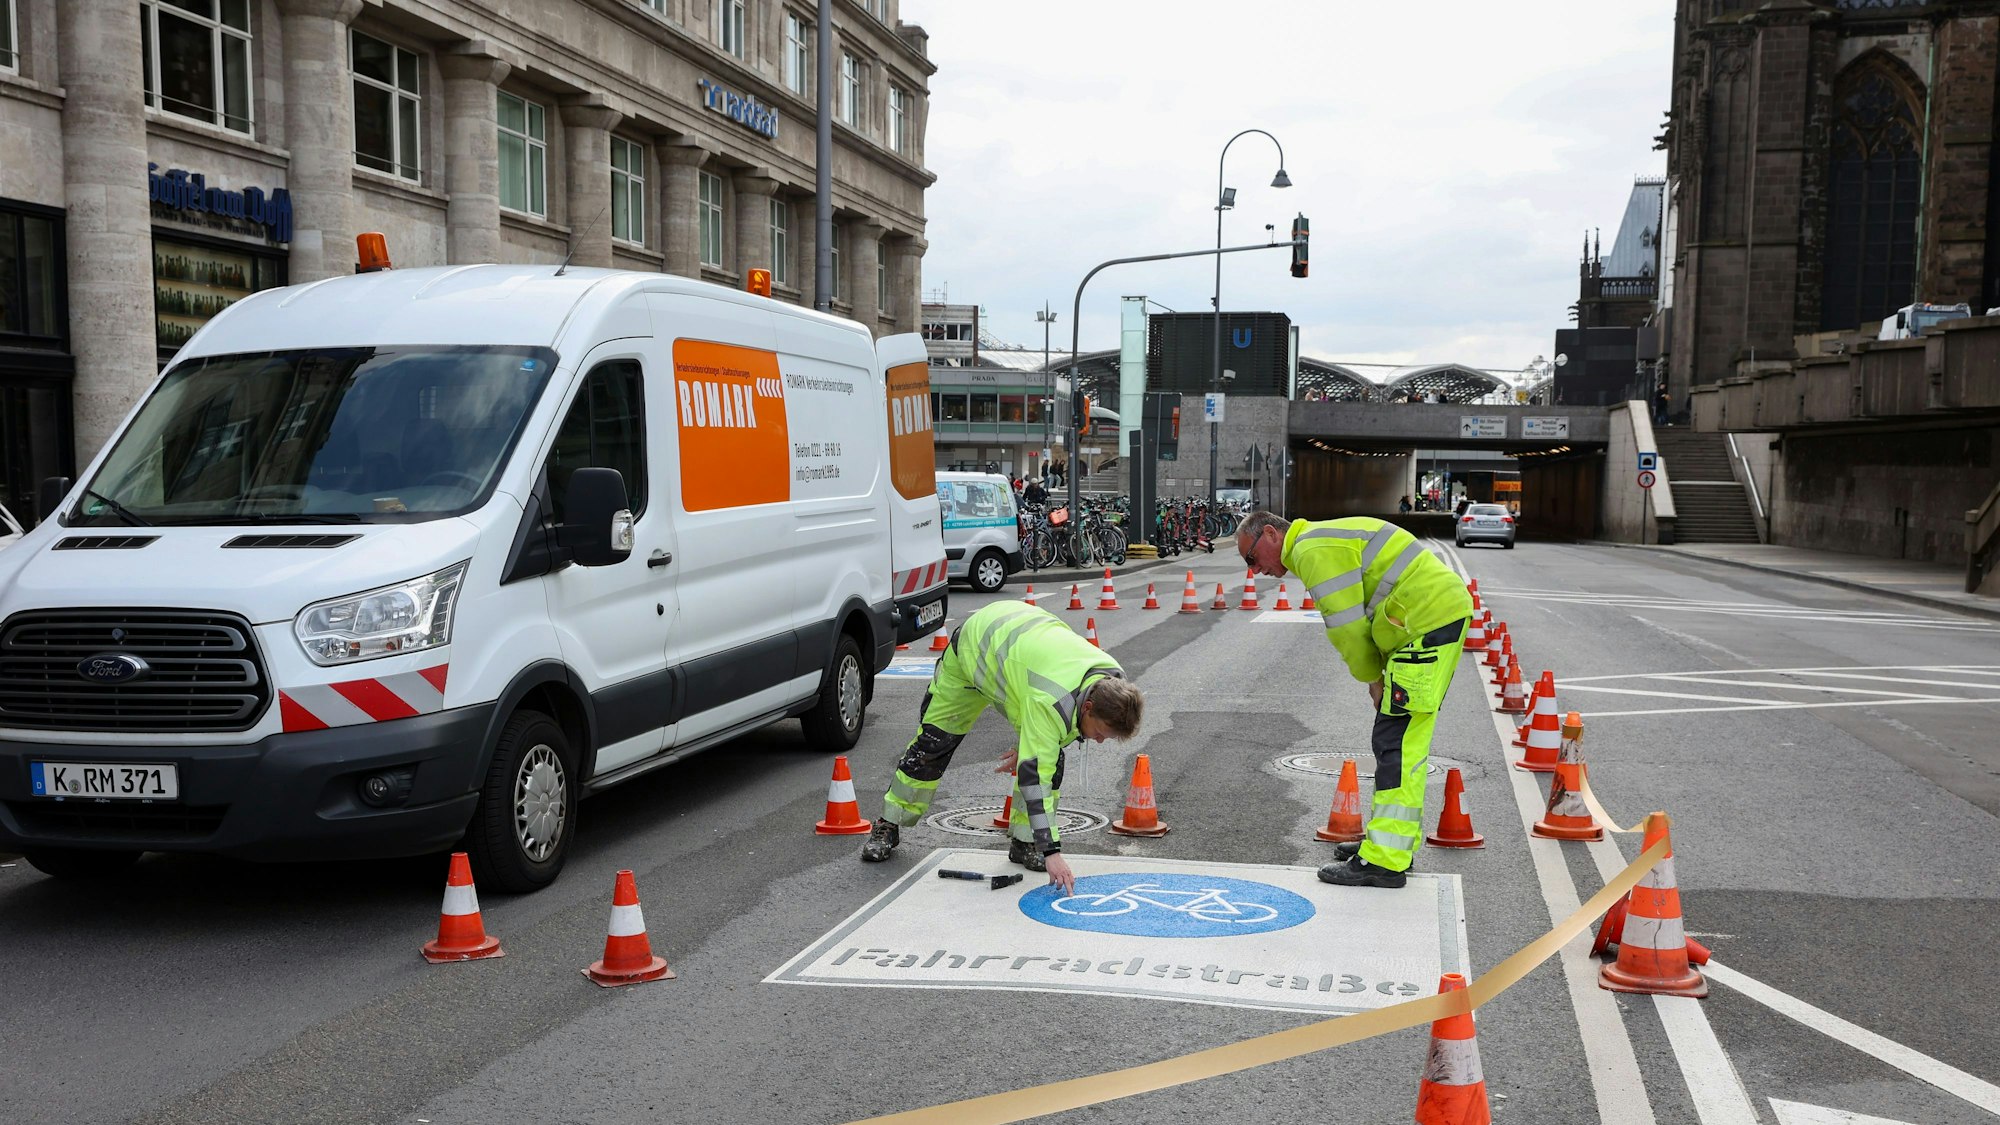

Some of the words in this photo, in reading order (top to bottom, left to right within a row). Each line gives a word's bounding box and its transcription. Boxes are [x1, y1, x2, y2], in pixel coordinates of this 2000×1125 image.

[1233, 328, 1252, 349] U
[786, 373, 807, 389] ROMARK
[678, 380, 757, 429] ROMARK
[892, 393, 933, 437] ROMA
[795, 443, 811, 458] Telefon
[811, 443, 821, 457] 0221
[88, 659, 123, 676] Ford
[36, 781, 42, 789] D
[53, 767, 68, 792] K
[83, 768, 115, 793] RM
[120, 768, 166, 794] 371
[831, 948, 1419, 996] Fahrradstraße
